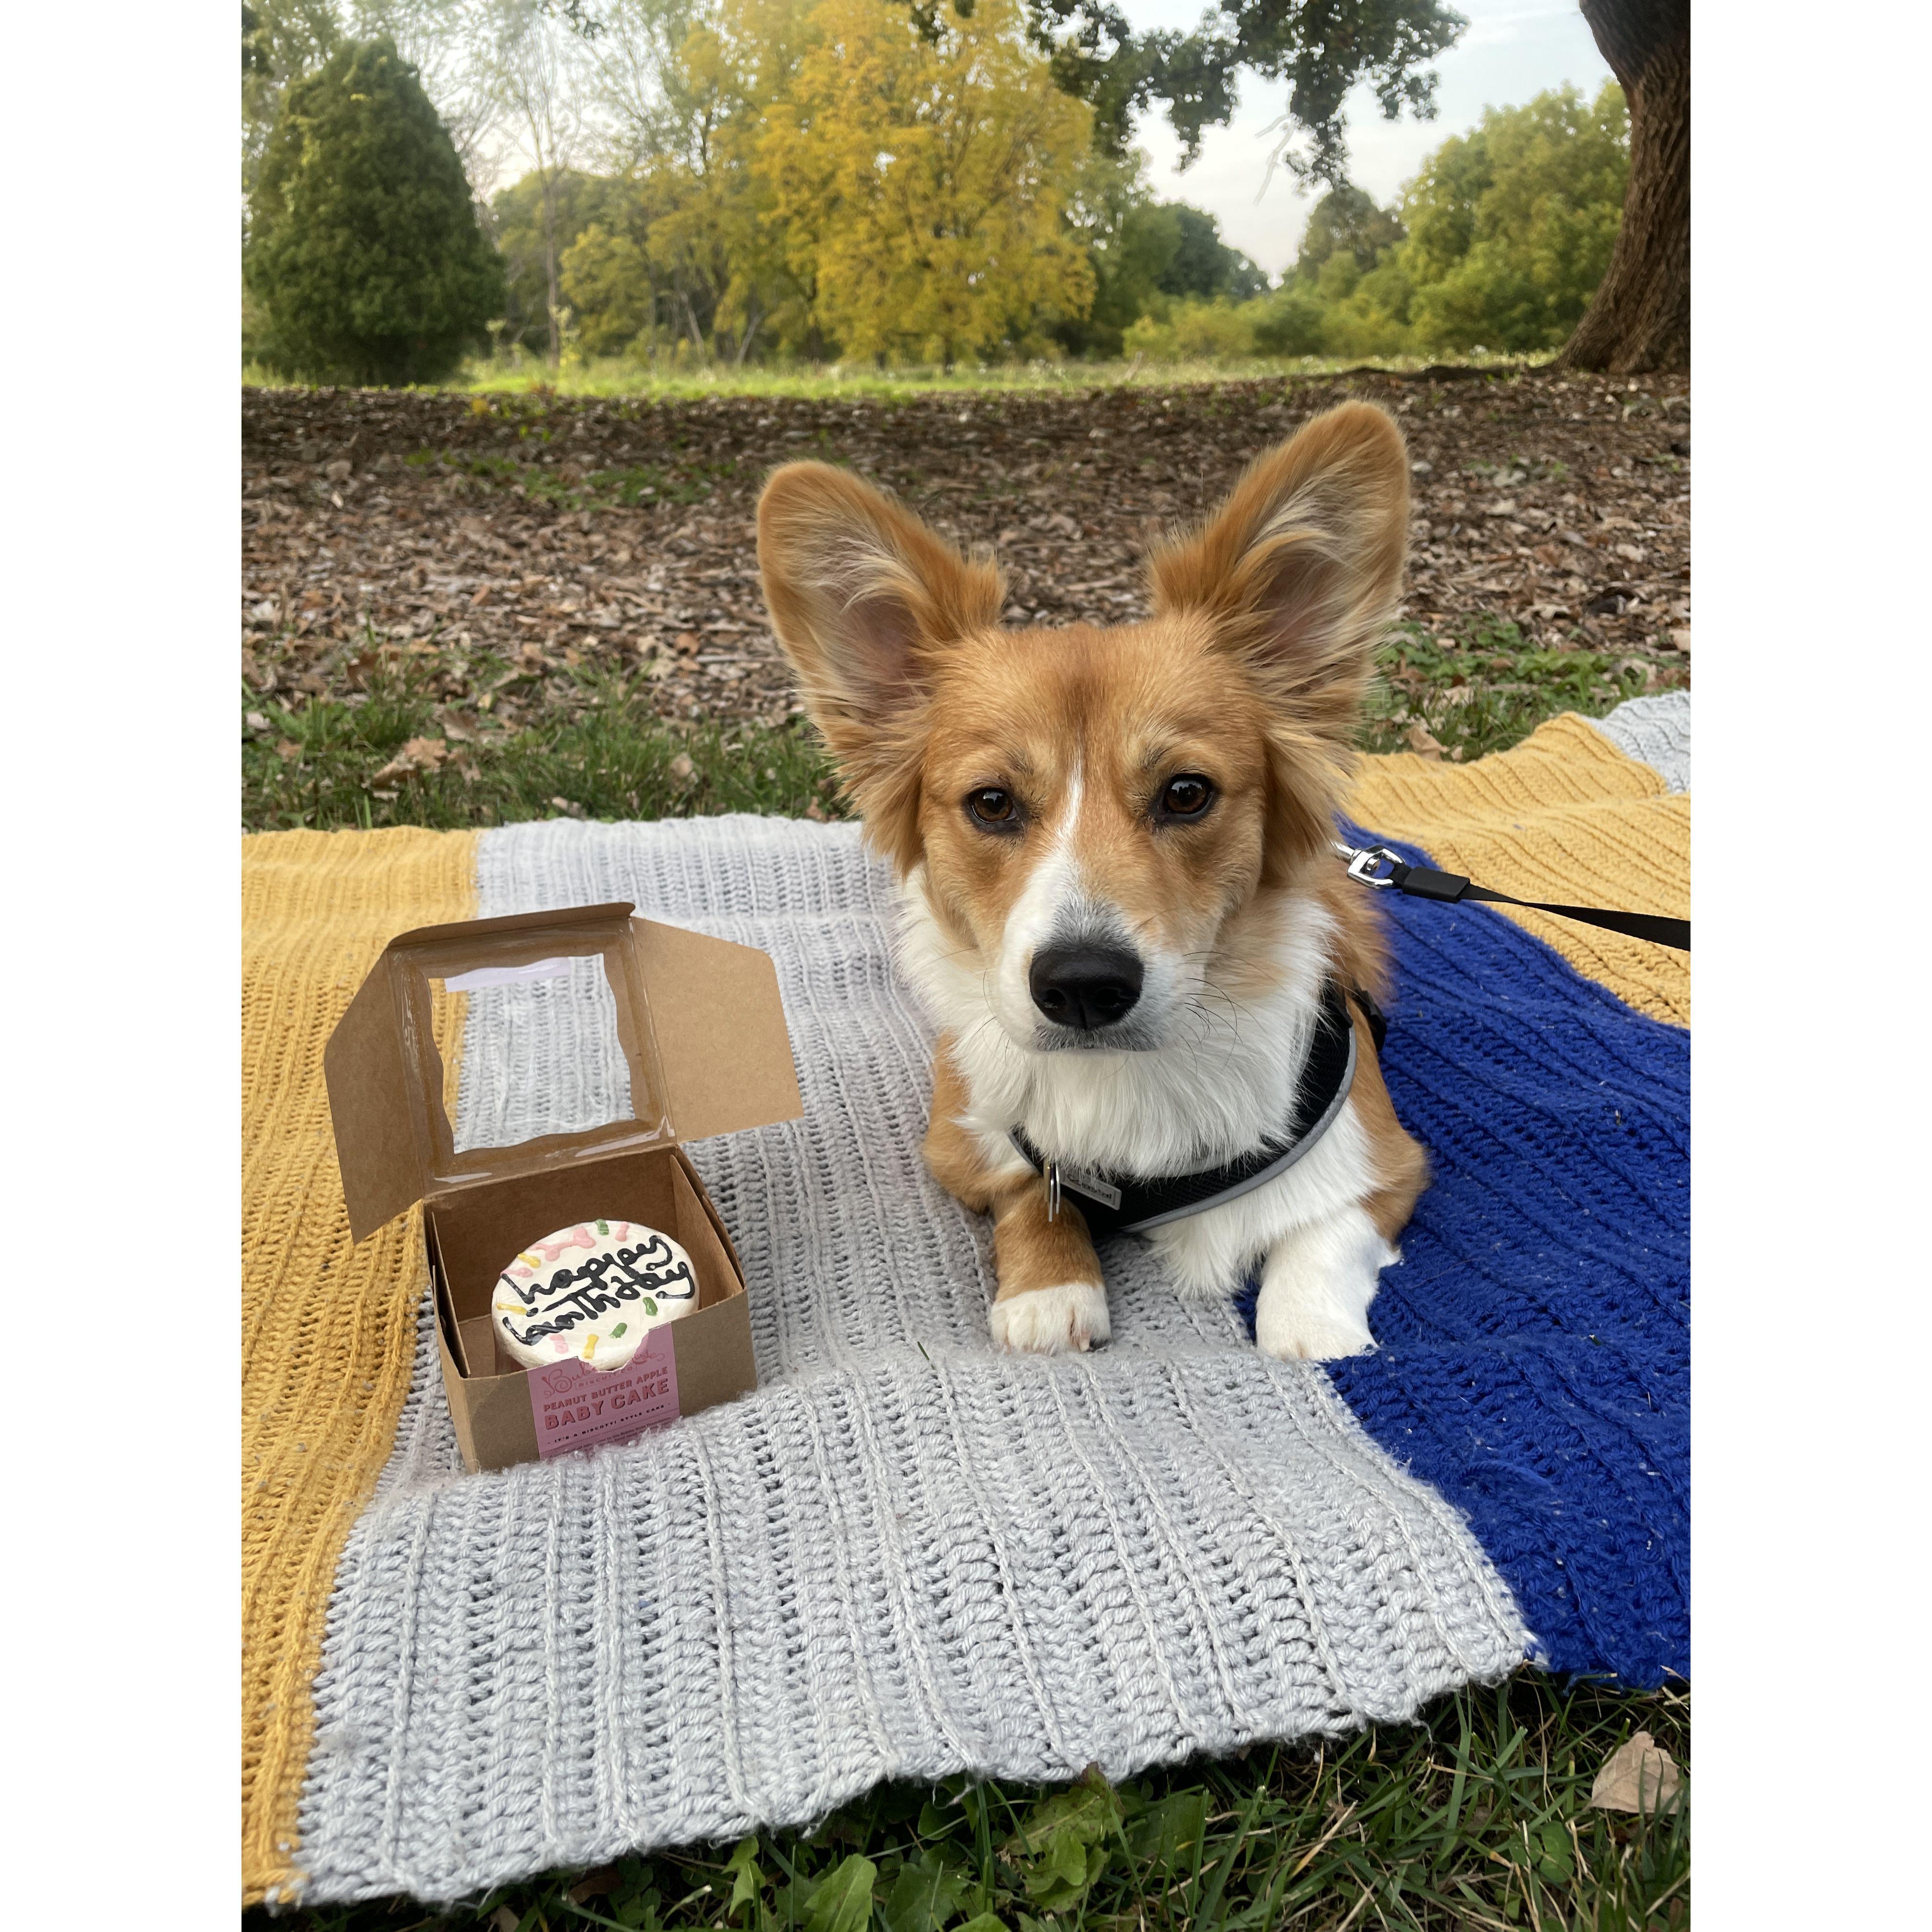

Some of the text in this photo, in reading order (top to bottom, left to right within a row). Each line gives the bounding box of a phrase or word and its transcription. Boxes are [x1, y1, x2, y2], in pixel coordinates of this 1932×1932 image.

[501, 1235, 673, 1304] happy
[543, 1366, 668, 1412] PEANUT BUTTER APPLE
[544, 1378, 669, 1430] BABY CAKE
[582, 1421, 617, 1434] BISCOTTI
[621, 1413, 642, 1422] STYLE
[646, 1404, 665, 1413] CAKE
